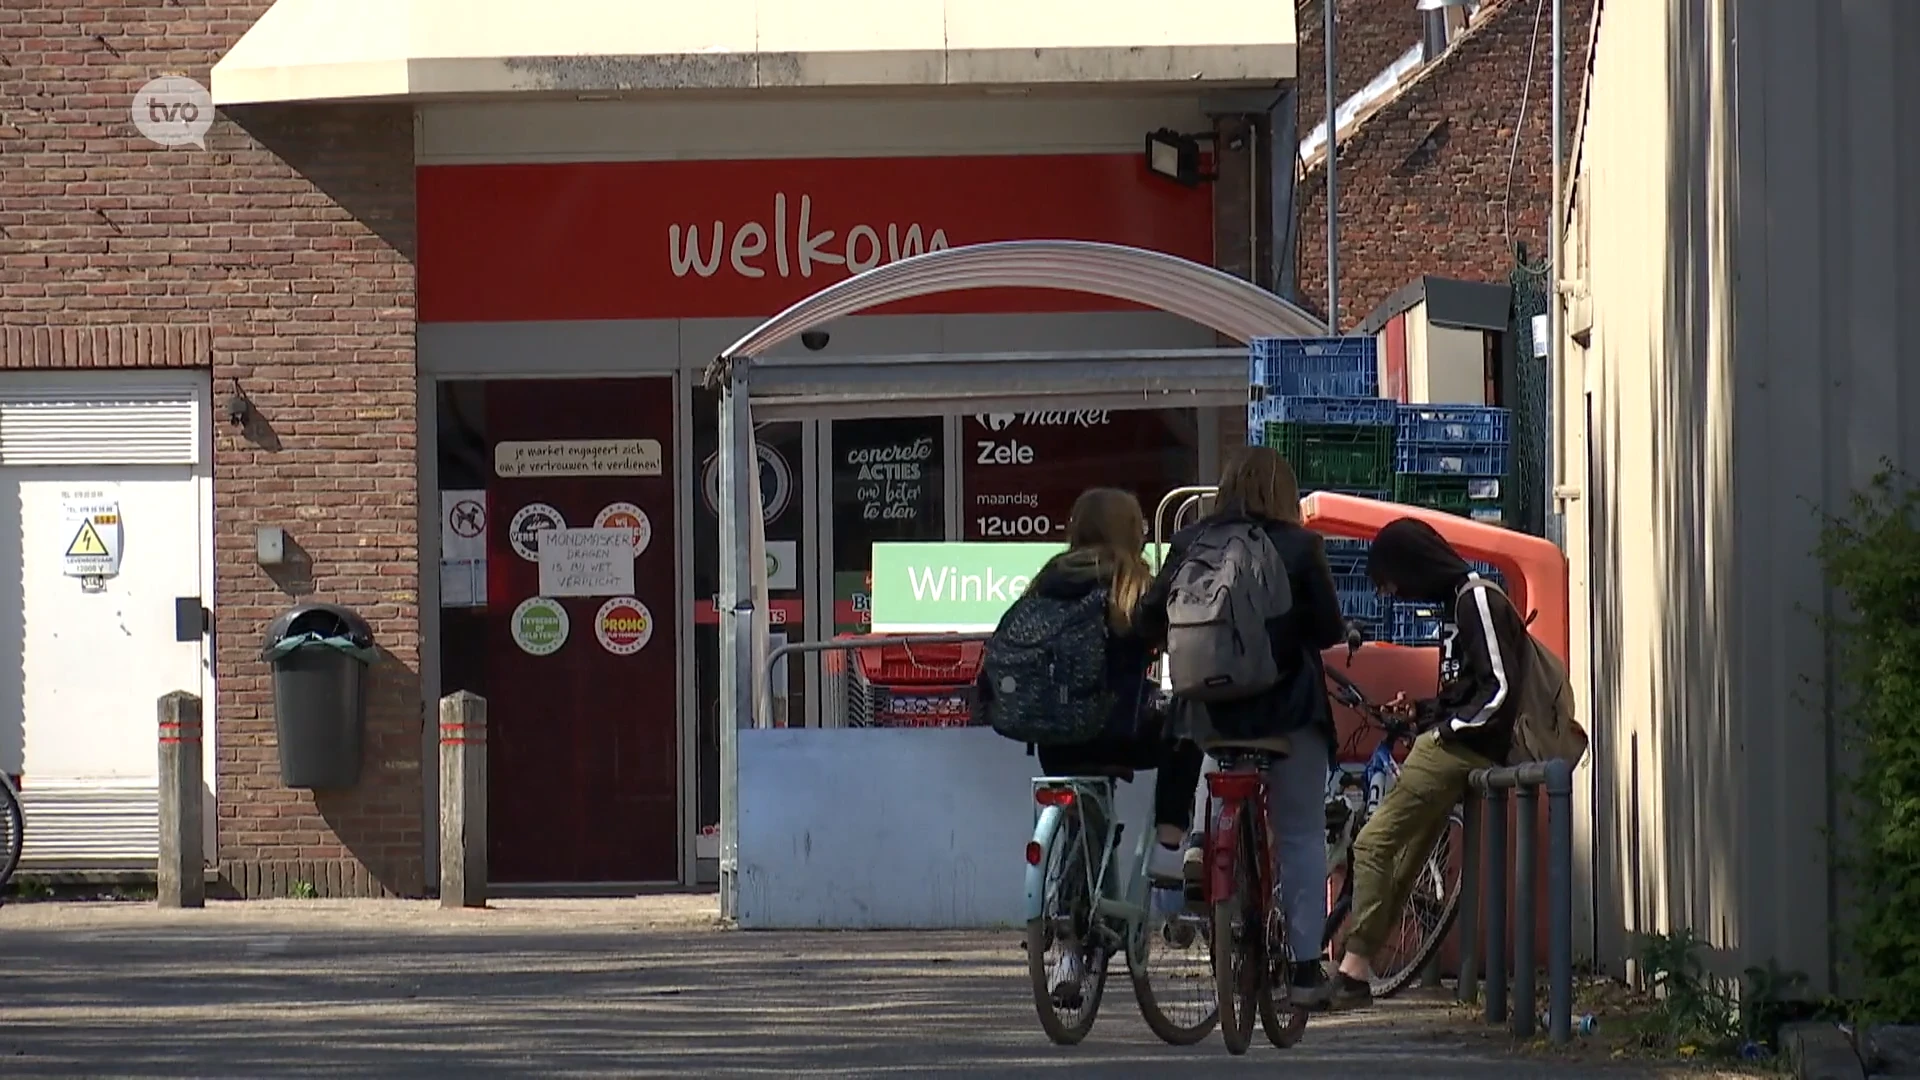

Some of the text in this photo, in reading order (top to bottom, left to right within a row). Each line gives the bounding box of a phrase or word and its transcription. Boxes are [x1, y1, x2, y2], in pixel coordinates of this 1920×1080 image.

[668, 192, 951, 278] welkom
[1022, 408, 1111, 428] market
[515, 443, 645, 460] je market engageert zich
[847, 437, 933, 465] concrete
[977, 439, 1034, 465] Zele
[500, 457, 661, 475] om je vertrouwen te verdienen!
[857, 463, 921, 480] ACTIES
[857, 482, 880, 501] om
[976, 491, 1039, 508] maandag
[863, 501, 917, 519] te eten
[976, 515, 1050, 537] 12u00
[546, 532, 631, 548] MONDMASKER
[567, 549, 610, 560] DRAGEN
[552, 562, 563, 573] IS
[557, 575, 621, 588] VERPLICHT
[907, 566, 1040, 602] Winke
[601, 616, 648, 632] PROMO
